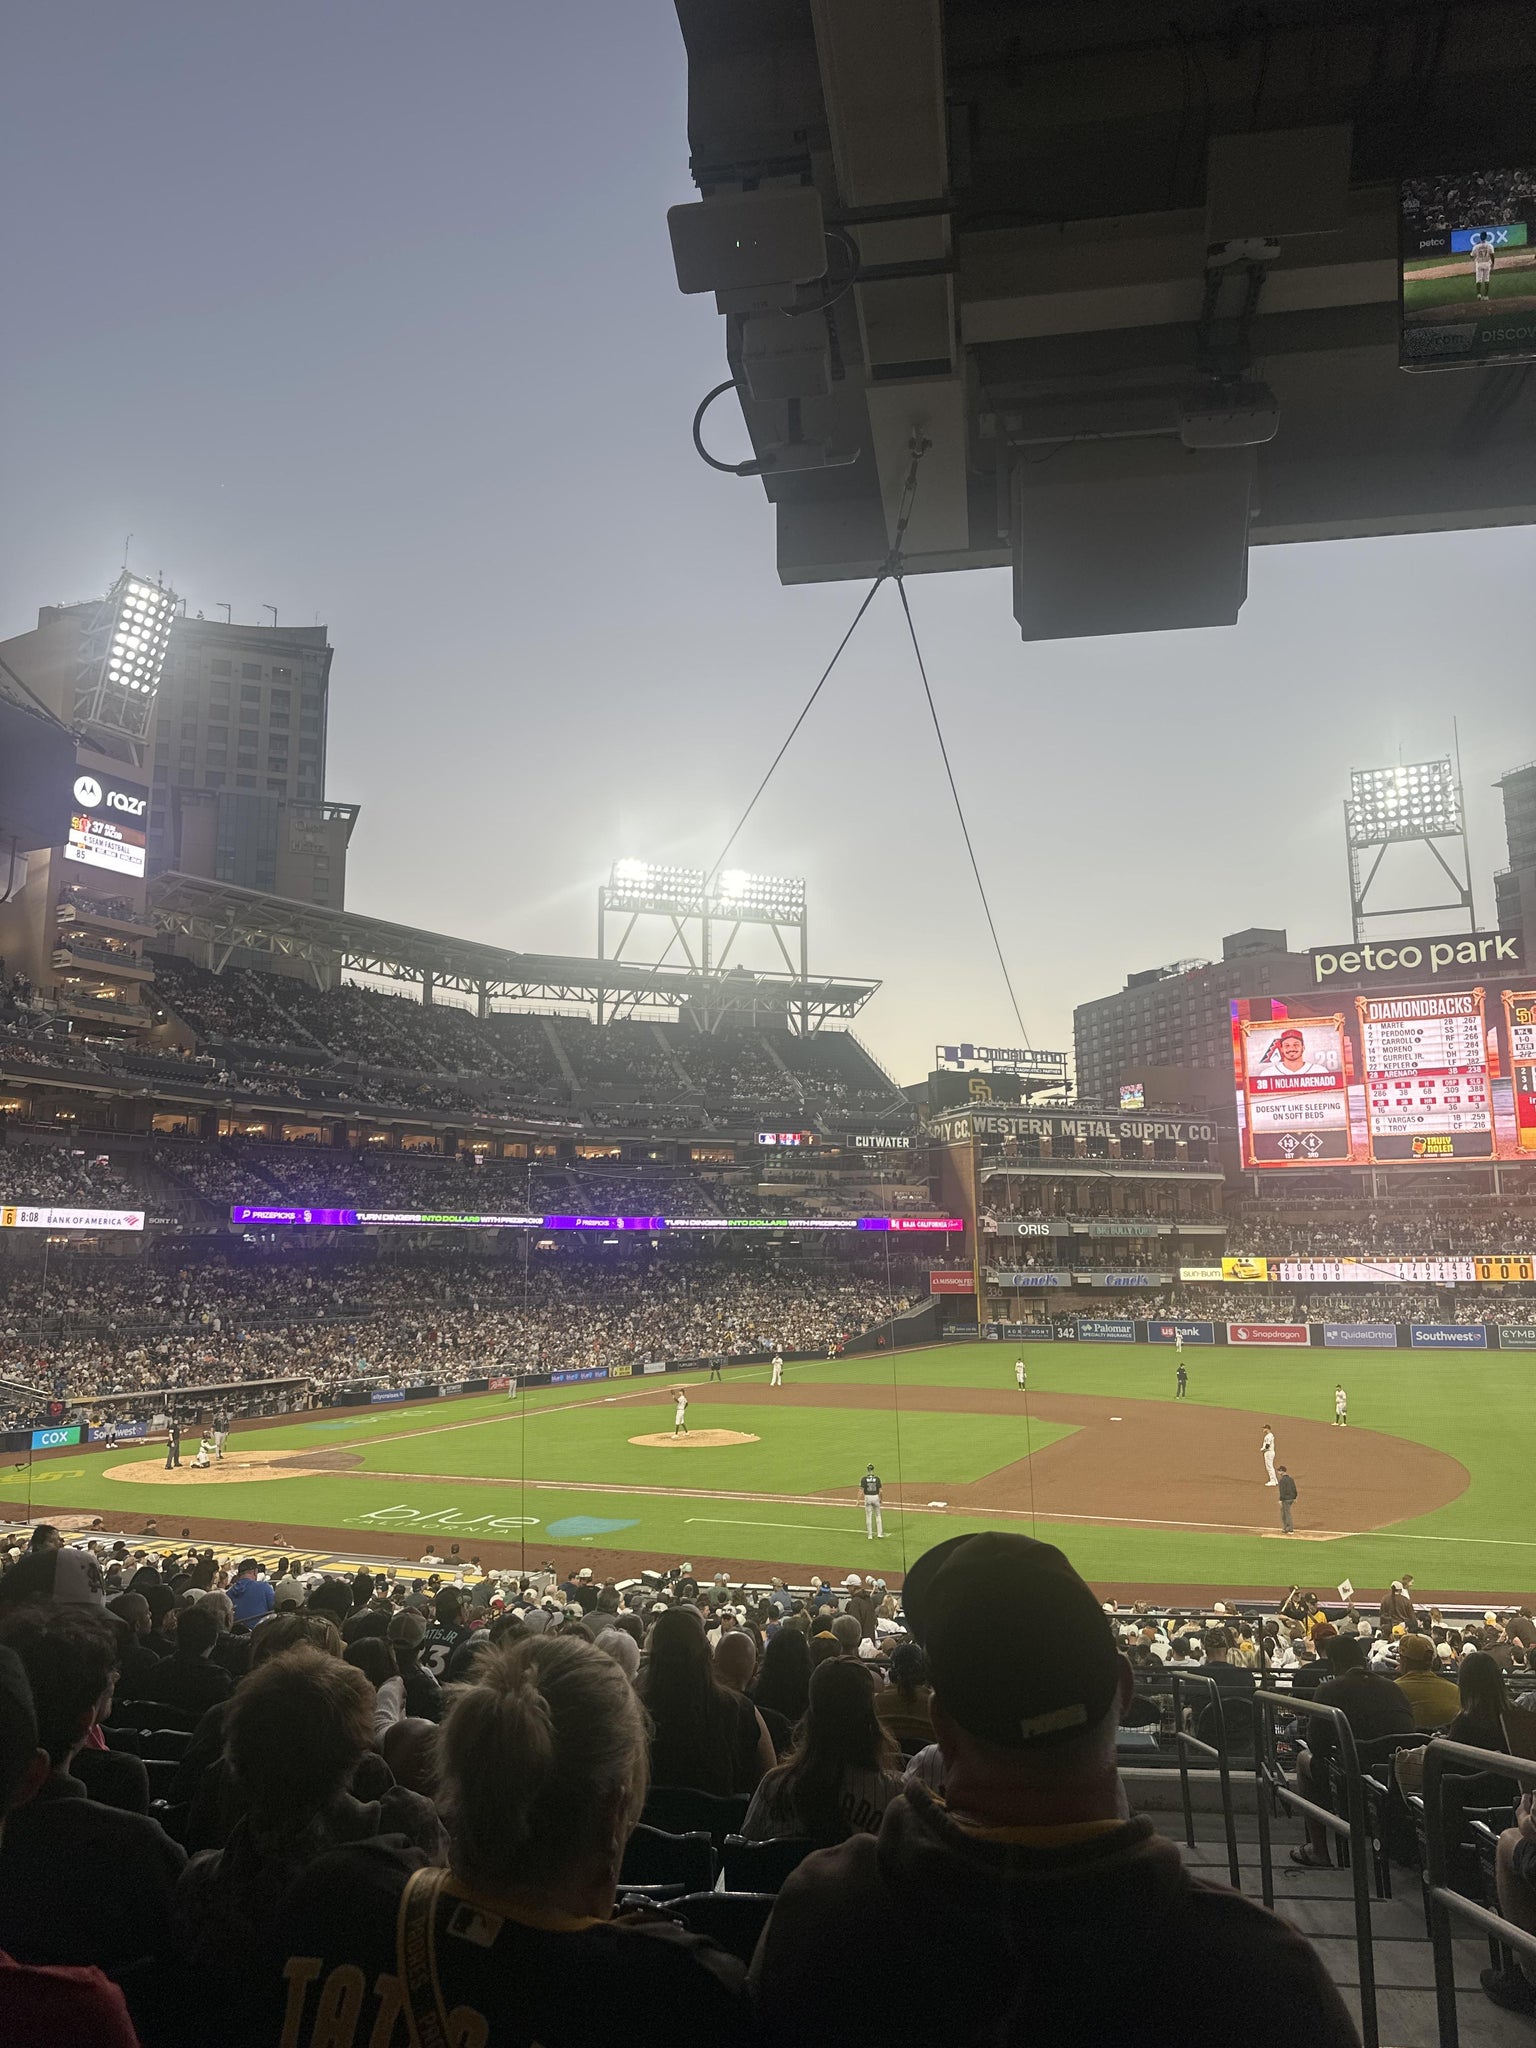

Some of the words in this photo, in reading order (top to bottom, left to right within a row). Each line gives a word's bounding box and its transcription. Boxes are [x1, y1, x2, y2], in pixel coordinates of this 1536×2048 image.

[1420, 238, 1445, 249] petco
[106, 791, 146, 816] razr
[92, 821, 104, 834] 37
[104, 840, 130, 854] FASTBALL
[76, 850, 86, 859] 85
[1315, 945, 1422, 982] petco
[1430, 936, 1519, 974] park
[1370, 996, 1472, 1020] DIAMONDBACKS
[1315, 1051, 1337, 1070] 28
[1275, 1078, 1299, 1088] NOLAN
[1300, 1076, 1335, 1087] ARENADO
[1305, 1103, 1340, 1111] SLEEPING
[972, 1116, 1053, 1136] WESTERN
[1061, 1120, 1116, 1137] METAL
[1120, 1122, 1181, 1140] SUPPLY
[1189, 1125, 1216, 1141] CO.
[856, 1136, 910, 1148] CUTWATER
[1427, 1136, 1451, 1144] TRULY
[21, 1212, 38, 1222] 8:08
[1018, 1224, 1050, 1236] ORIS
[1482, 1265, 1490, 1279] 0
[1501, 1265, 1509, 1279] 0
[1520, 1265, 1528, 1279] 0
[1012, 1274, 1058, 1286] Canel's
[1106, 1274, 1149, 1286] Canel's
[987, 1286, 1003, 1297] 336
[1057, 1328, 1075, 1339] 342
[1094, 1324, 1131, 1332] Palomar
[1252, 1330, 1300, 1340] Snapdragon
[1340, 1330, 1393, 1340] QuidelOrtho
[1416, 1330, 1473, 1341] Southwest
[42, 1432, 68, 1444] COX
[360, 1504, 540, 1529] blue
[342, 1518, 509, 1534] CALIFORNIA
[442, 1630, 458, 1644] JR
[418, 1644, 450, 1675] 3
